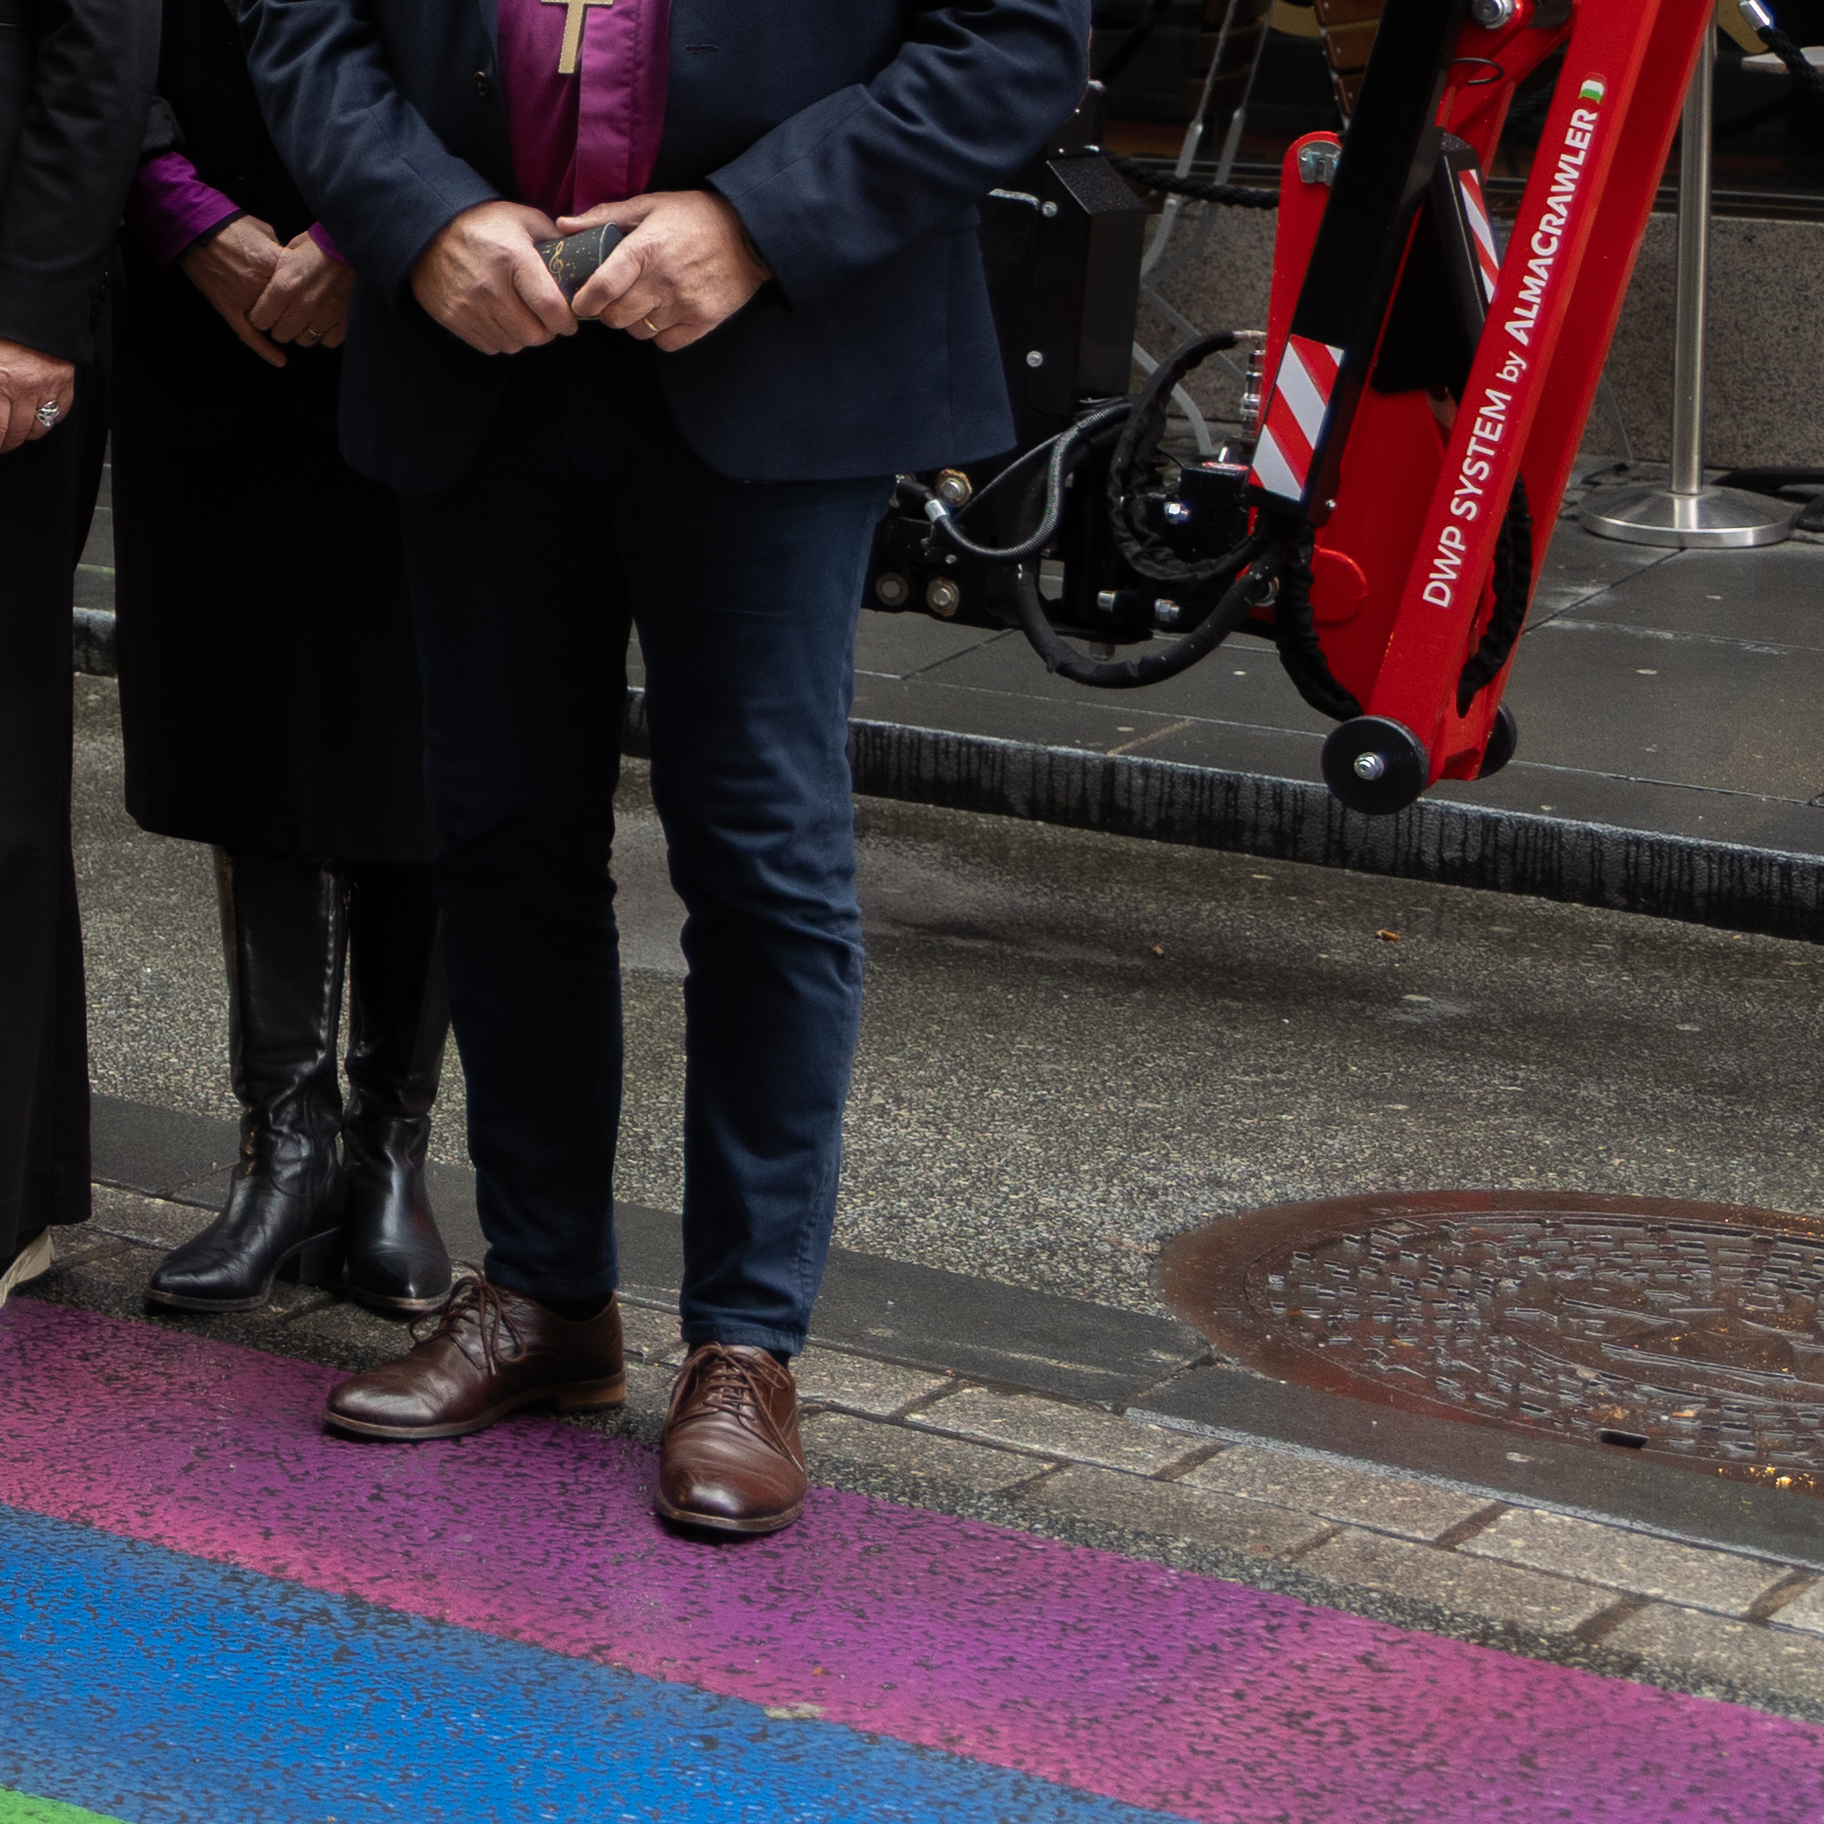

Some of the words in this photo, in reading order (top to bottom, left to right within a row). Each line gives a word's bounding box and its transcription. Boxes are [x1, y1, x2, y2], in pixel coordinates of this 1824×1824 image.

[1504, 108, 1598, 346] ALMACRAWLER
[1496, 351, 1527, 383] by
[1450, 388, 1512, 521] SYSTEM
[1422, 526, 1466, 608] DWP
